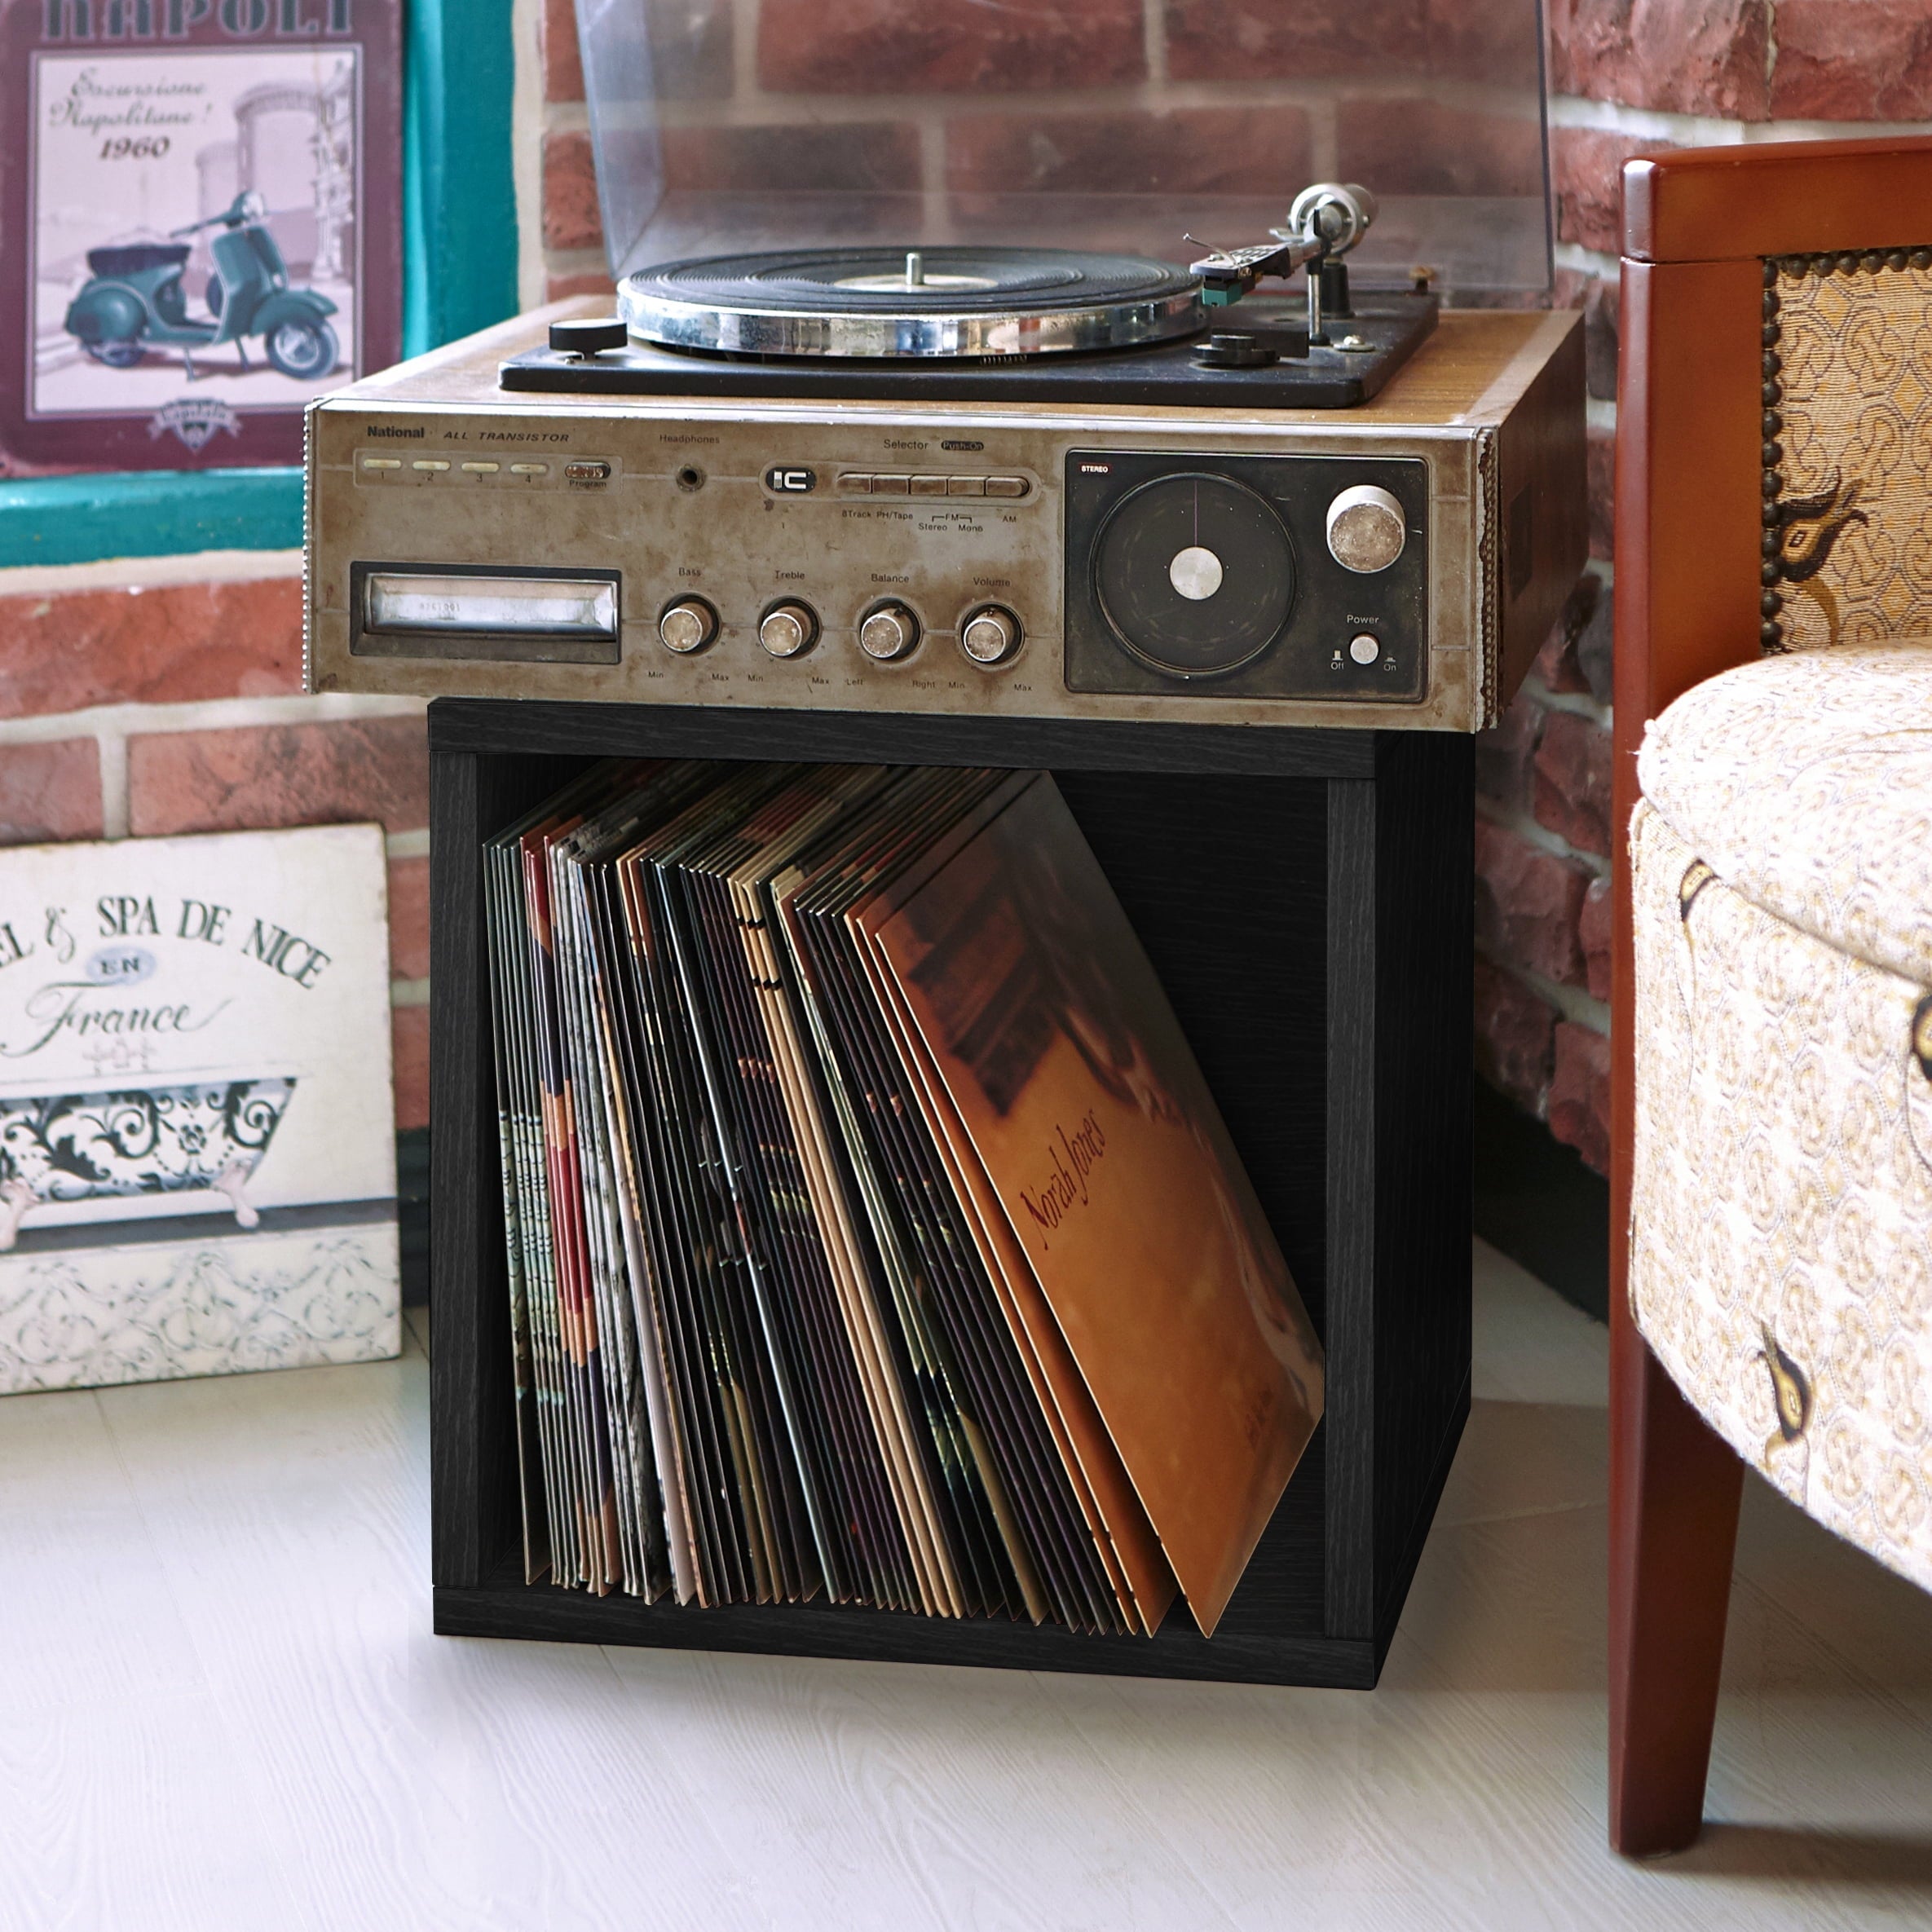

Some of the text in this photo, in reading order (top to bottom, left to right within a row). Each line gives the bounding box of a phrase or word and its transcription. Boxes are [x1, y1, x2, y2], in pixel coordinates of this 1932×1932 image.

[100, 136, 170, 160] 1960
[367, 426, 425, 439] National
[443, 430, 570, 443] ALL TRANSISTOR
[659, 434, 721, 444] Headphones
[884, 439, 929, 450] Selector
[1081, 465, 1109, 474] STEREO
[426, 472, 434, 482] 2
[476, 473, 483, 483] 3
[524, 474, 532, 483] 4
[774, 470, 808, 490] IC
[569, 479, 607, 489] Program
[945, 514, 959, 522] FM
[1002, 514, 1017, 523] AM
[918, 523, 984, 532] Stereo Mono
[678, 567, 701, 577] Bass
[774, 570, 805, 580] Treble
[871, 573, 910, 584] Balance
[973, 577, 1011, 588] Volume
[1347, 614, 1379, 624] Power
[1330, 662, 1344, 670] Off
[1383, 664, 1396, 672] On
[648, 671, 664, 679] Min
[712, 673, 730, 681] Max
[748, 674, 764, 682] Min
[812, 677, 830, 685] Max
[847, 677, 864, 686] Left
[912, 680, 936, 690] Right
[949, 681, 965, 690] Min
[1014, 683, 1033, 692] Max
[96, 894, 161, 937] SPA
[175, 898, 232, 946] DE
[241, 918, 332, 990] NICE
[101, 956, 140, 974] EN
[0, 977, 234, 1058] France
[1020, 1109, 1106, 1251] Norah Jones
